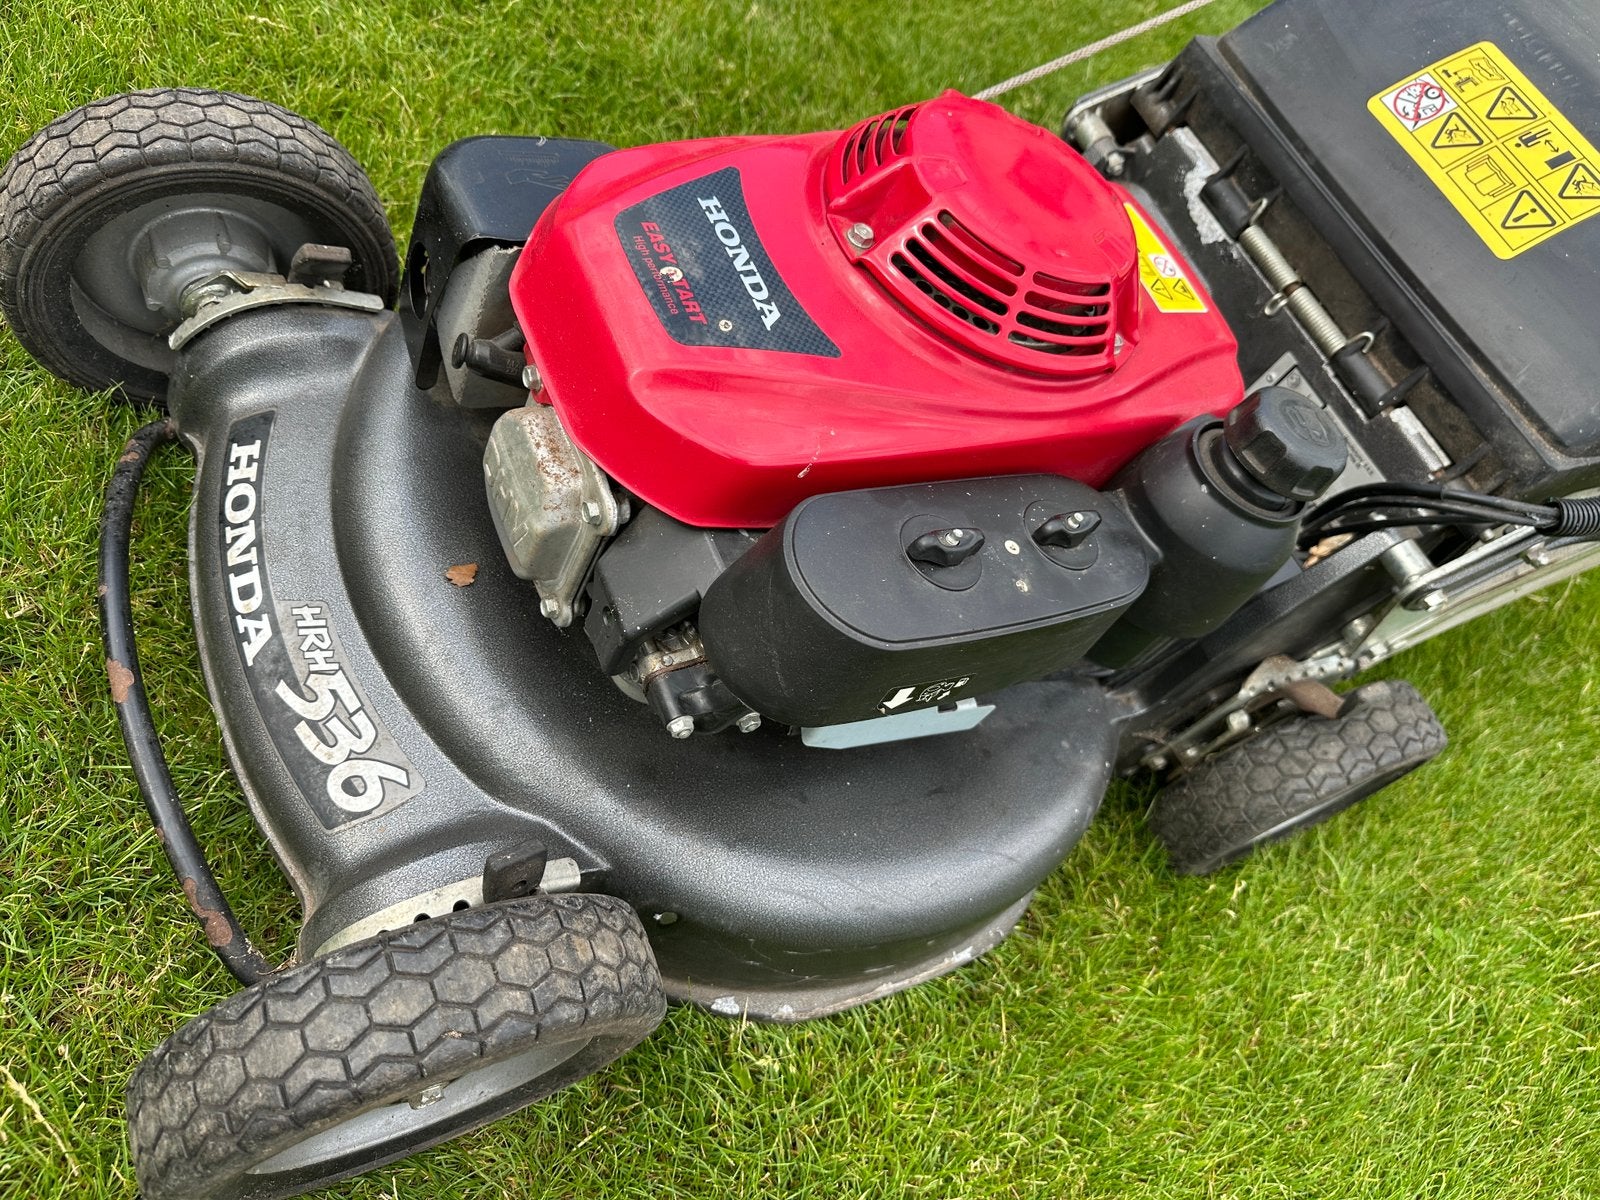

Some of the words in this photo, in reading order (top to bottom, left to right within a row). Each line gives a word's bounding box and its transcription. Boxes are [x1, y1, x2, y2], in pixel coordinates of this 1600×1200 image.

[633, 235, 651, 257] High
[644, 257, 679, 315] performance
[641, 222, 678, 265] EASY
[660, 266, 707, 325] TART
[698, 196, 781, 331] HONDA
[225, 440, 273, 667] HONDA
